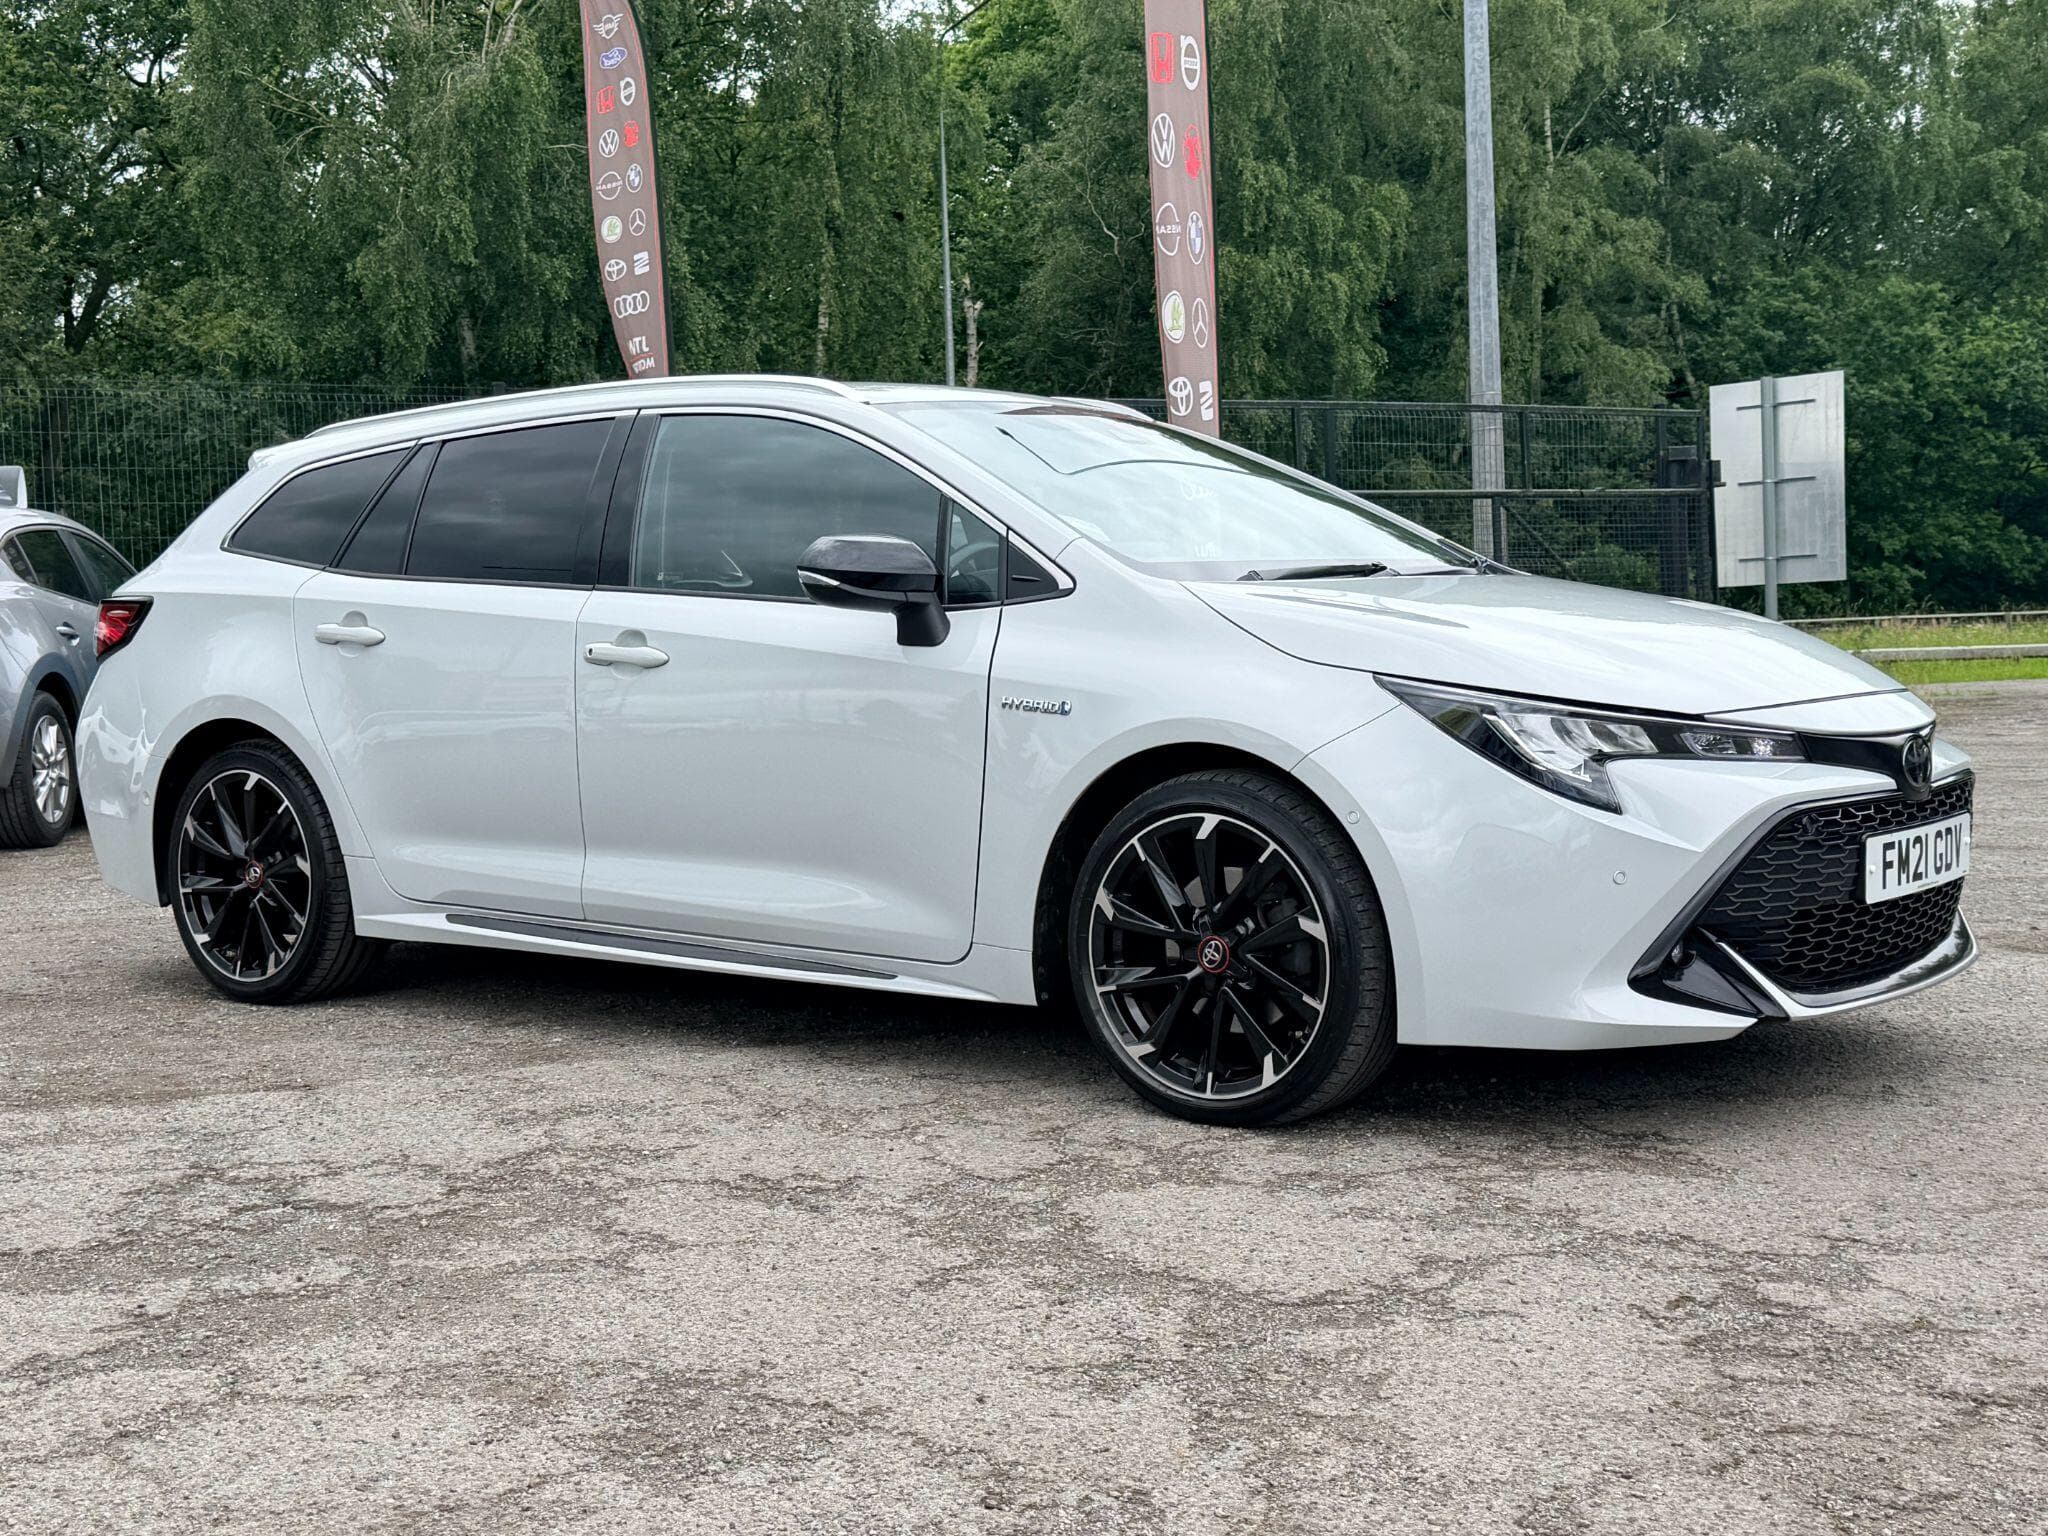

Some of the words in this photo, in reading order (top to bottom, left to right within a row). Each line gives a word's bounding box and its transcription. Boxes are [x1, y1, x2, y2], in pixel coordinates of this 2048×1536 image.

[1002, 696, 1060, 713] HYBRID
[1882, 833, 1929, 890] FM21
[1934, 823, 1962, 875] GDV
